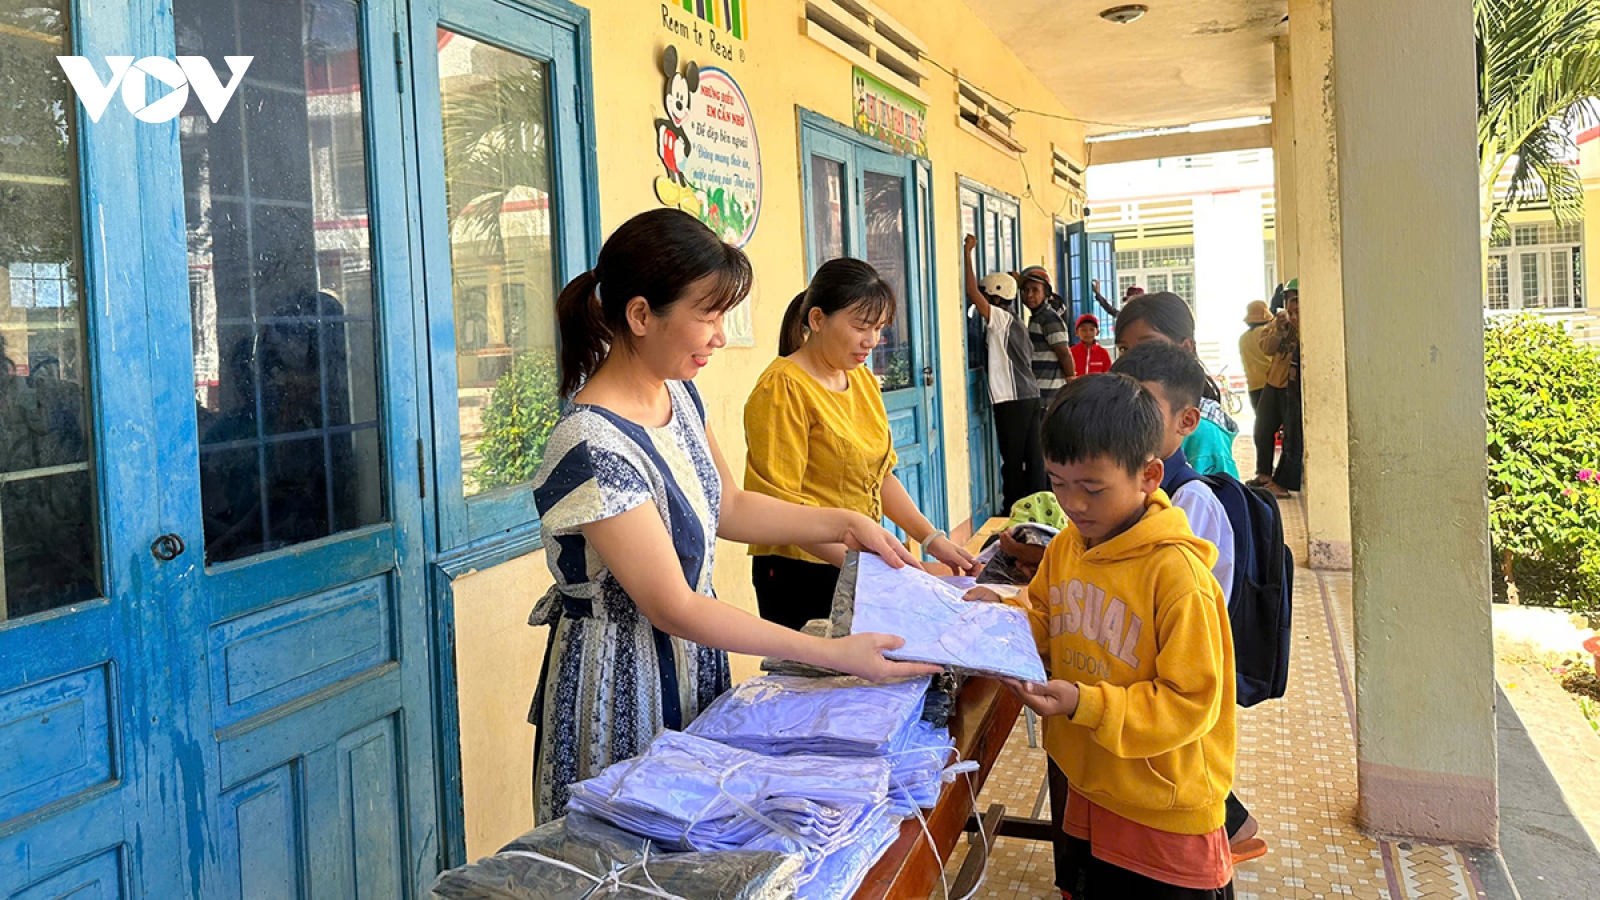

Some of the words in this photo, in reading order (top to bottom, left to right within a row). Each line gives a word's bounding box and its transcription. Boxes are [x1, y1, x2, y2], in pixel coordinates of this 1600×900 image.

[709, 29, 733, 61] Read
[706, 104, 716, 119] EM
[1049, 578, 1143, 669] CSUAL
